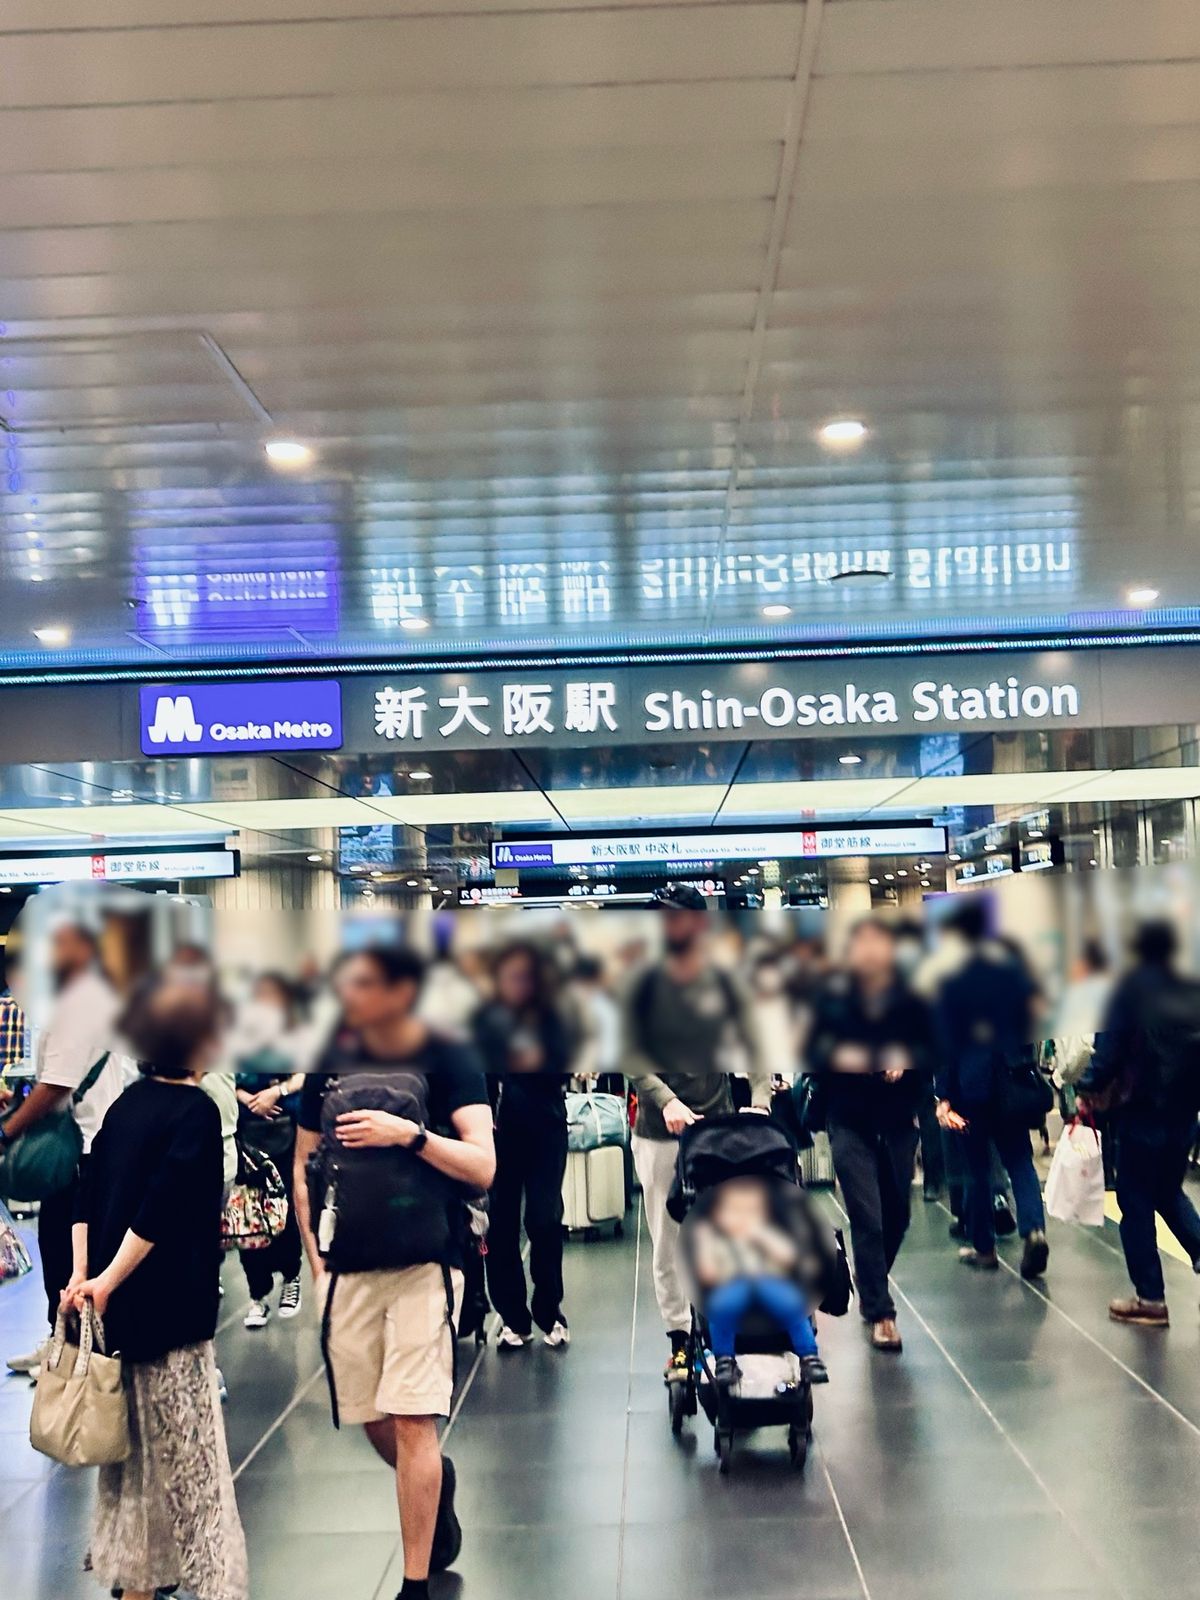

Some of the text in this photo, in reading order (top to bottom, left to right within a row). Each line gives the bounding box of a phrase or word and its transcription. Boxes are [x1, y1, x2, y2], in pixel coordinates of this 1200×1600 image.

[373, 682, 618, 740] 新大阪駅
[643, 676, 1079, 732] Shin-Osaka Station
[209, 721, 272, 741] Osaka
[273, 720, 333, 739] Metro
[591, 843, 641, 857] 新大阪駅
